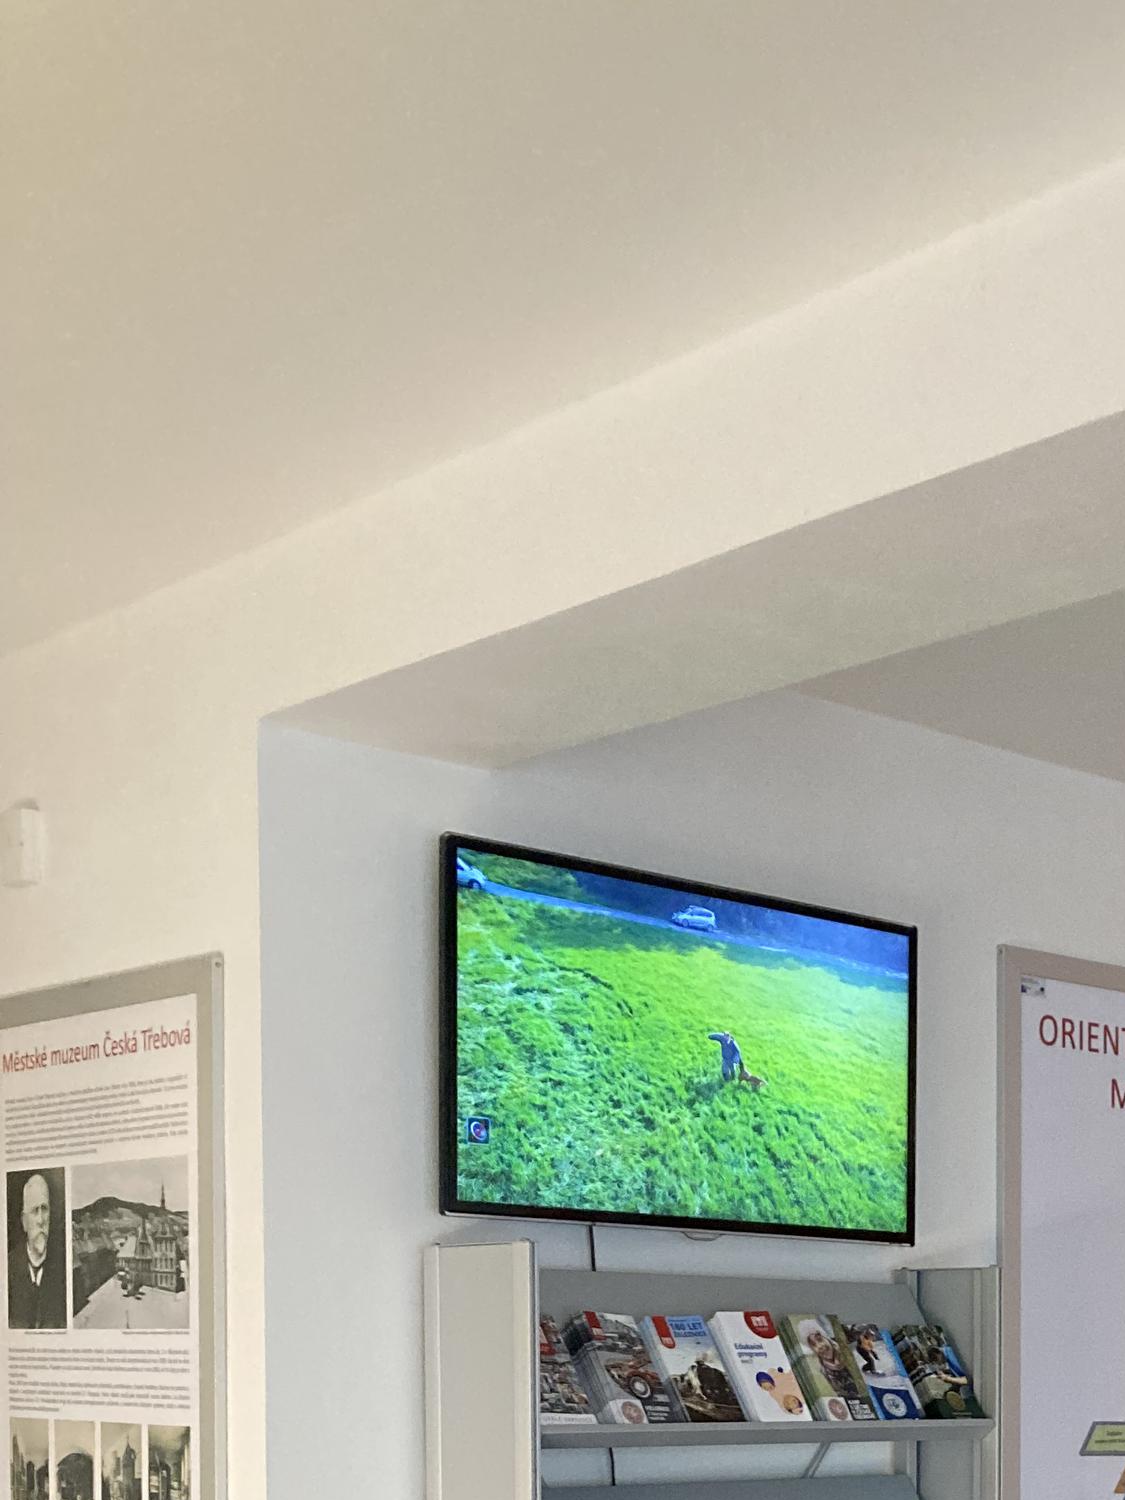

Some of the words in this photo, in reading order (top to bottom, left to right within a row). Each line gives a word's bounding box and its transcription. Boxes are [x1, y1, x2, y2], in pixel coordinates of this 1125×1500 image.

[2, 1045, 48, 1073] Městské
[51, 1043, 100, 1065] muzeum
[103, 1030, 137, 1057] Česká
[141, 1020, 191, 1051] Třebová
